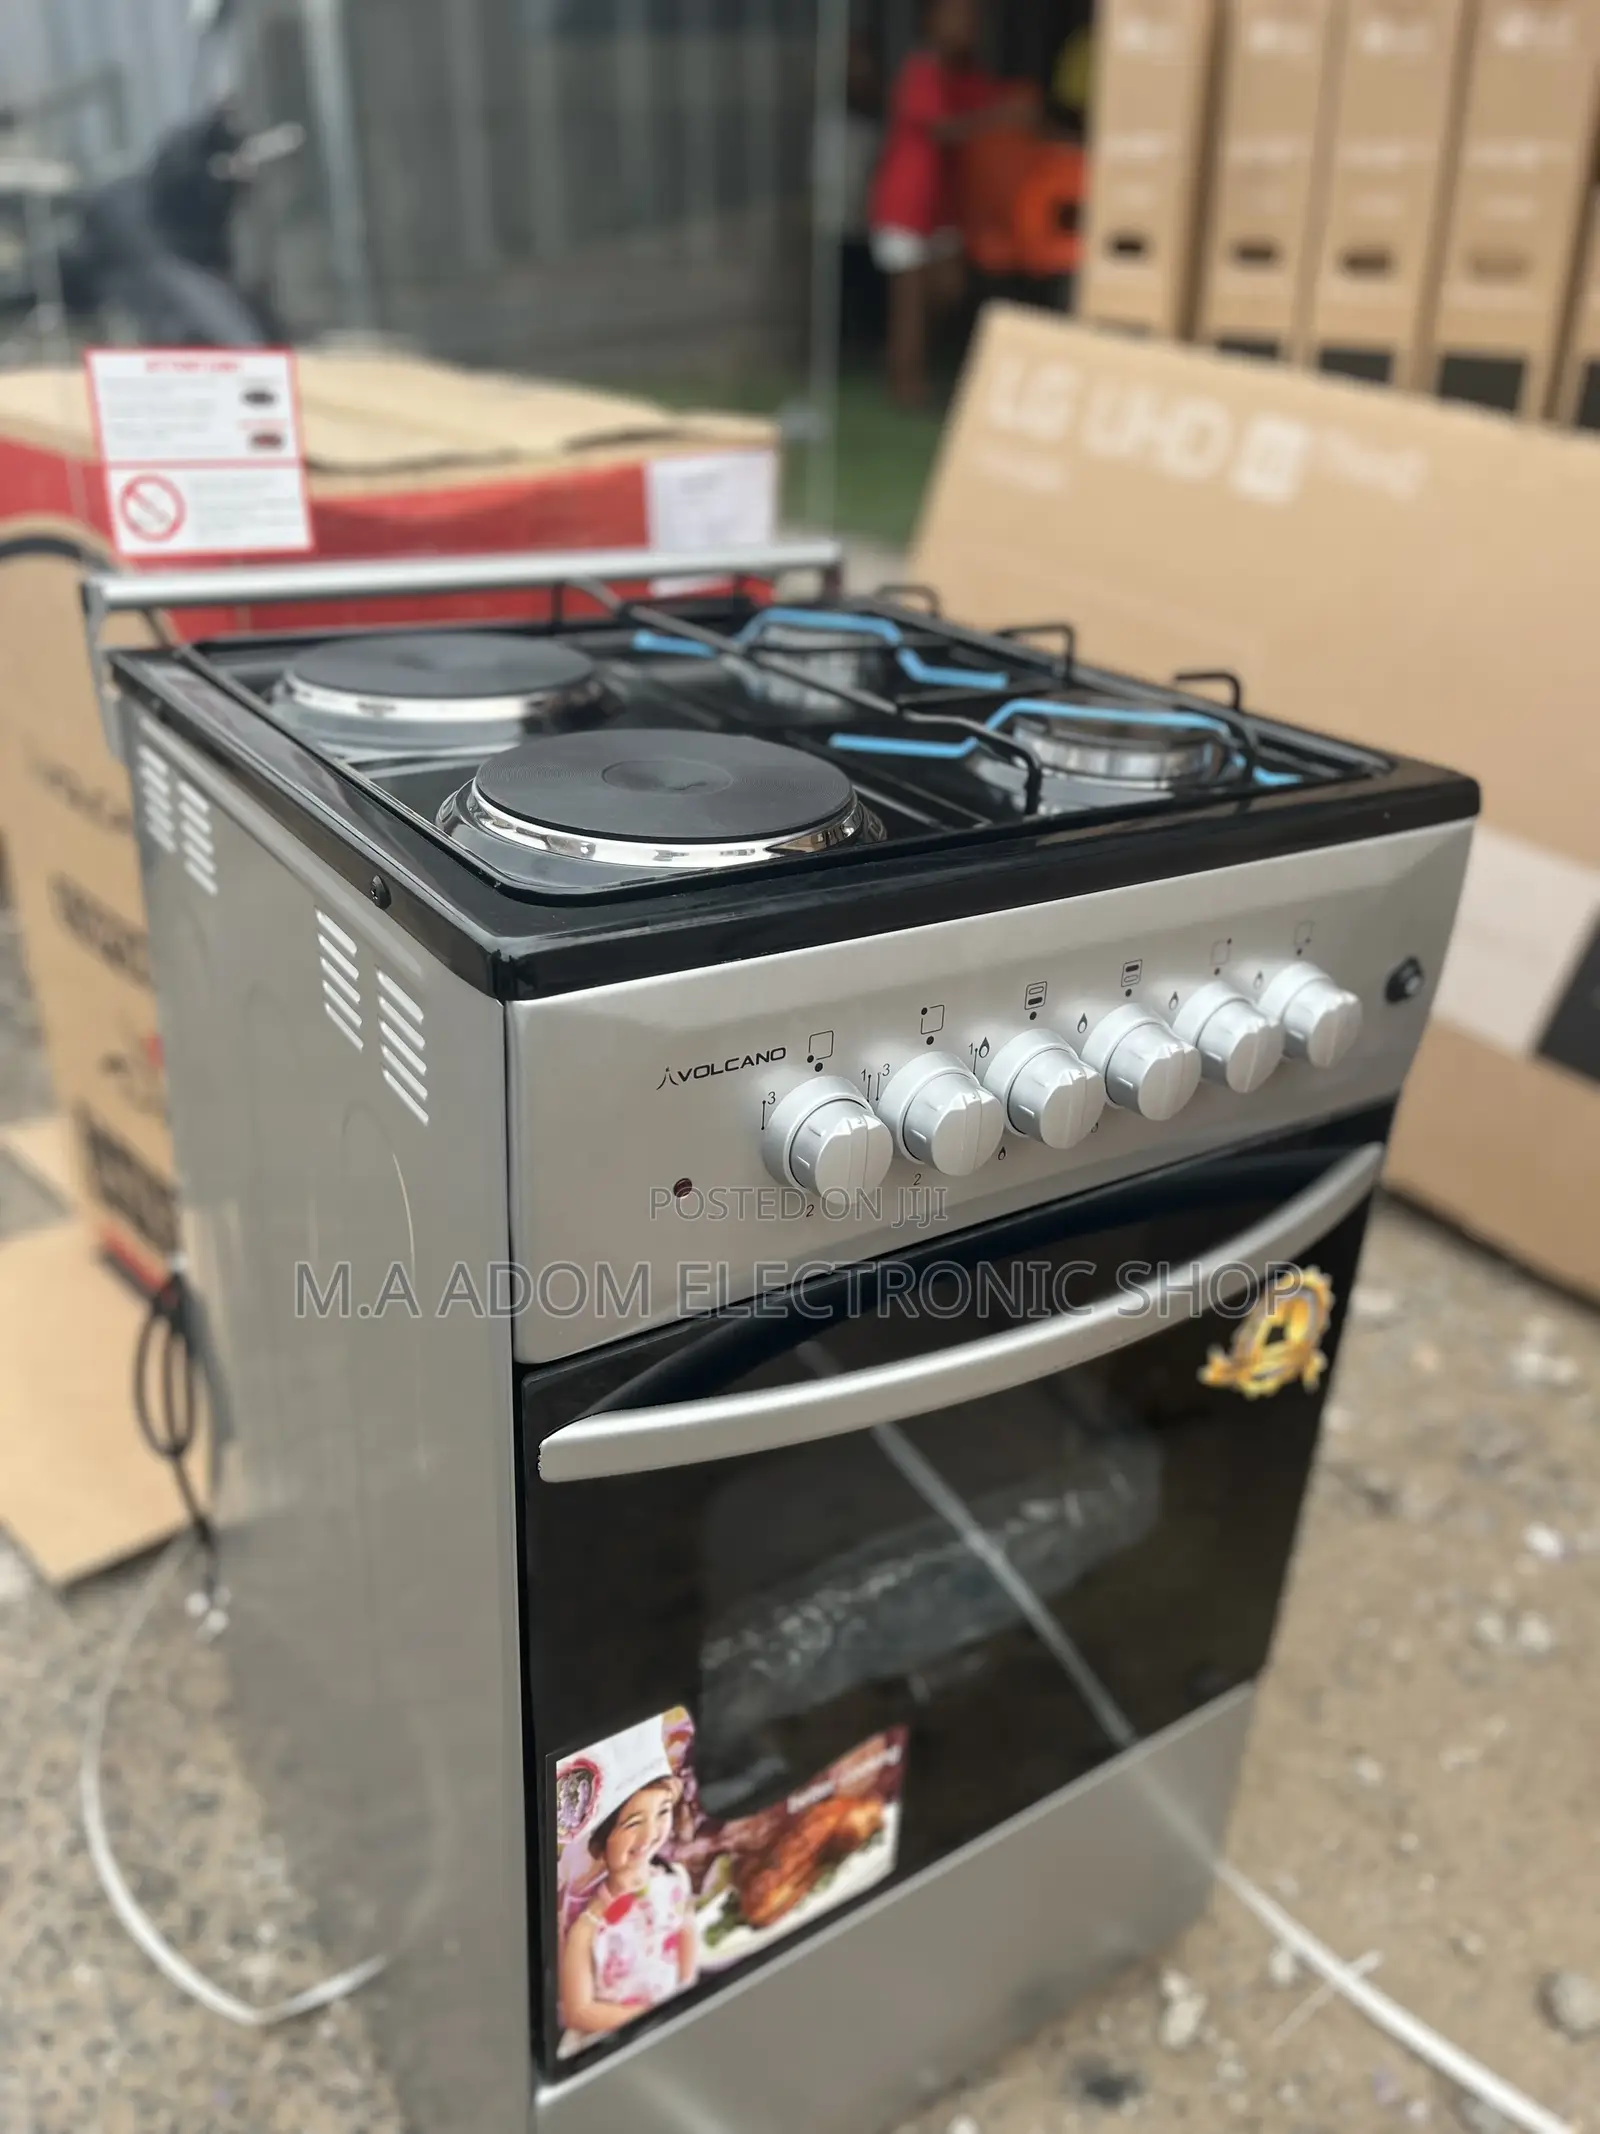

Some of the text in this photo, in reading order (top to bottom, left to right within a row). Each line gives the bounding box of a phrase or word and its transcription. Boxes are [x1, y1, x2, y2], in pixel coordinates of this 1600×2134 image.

[676, 1046, 787, 1083] VOLCANO
[766, 1091, 777, 1105] 3
[912, 1173, 922, 1186] 2
